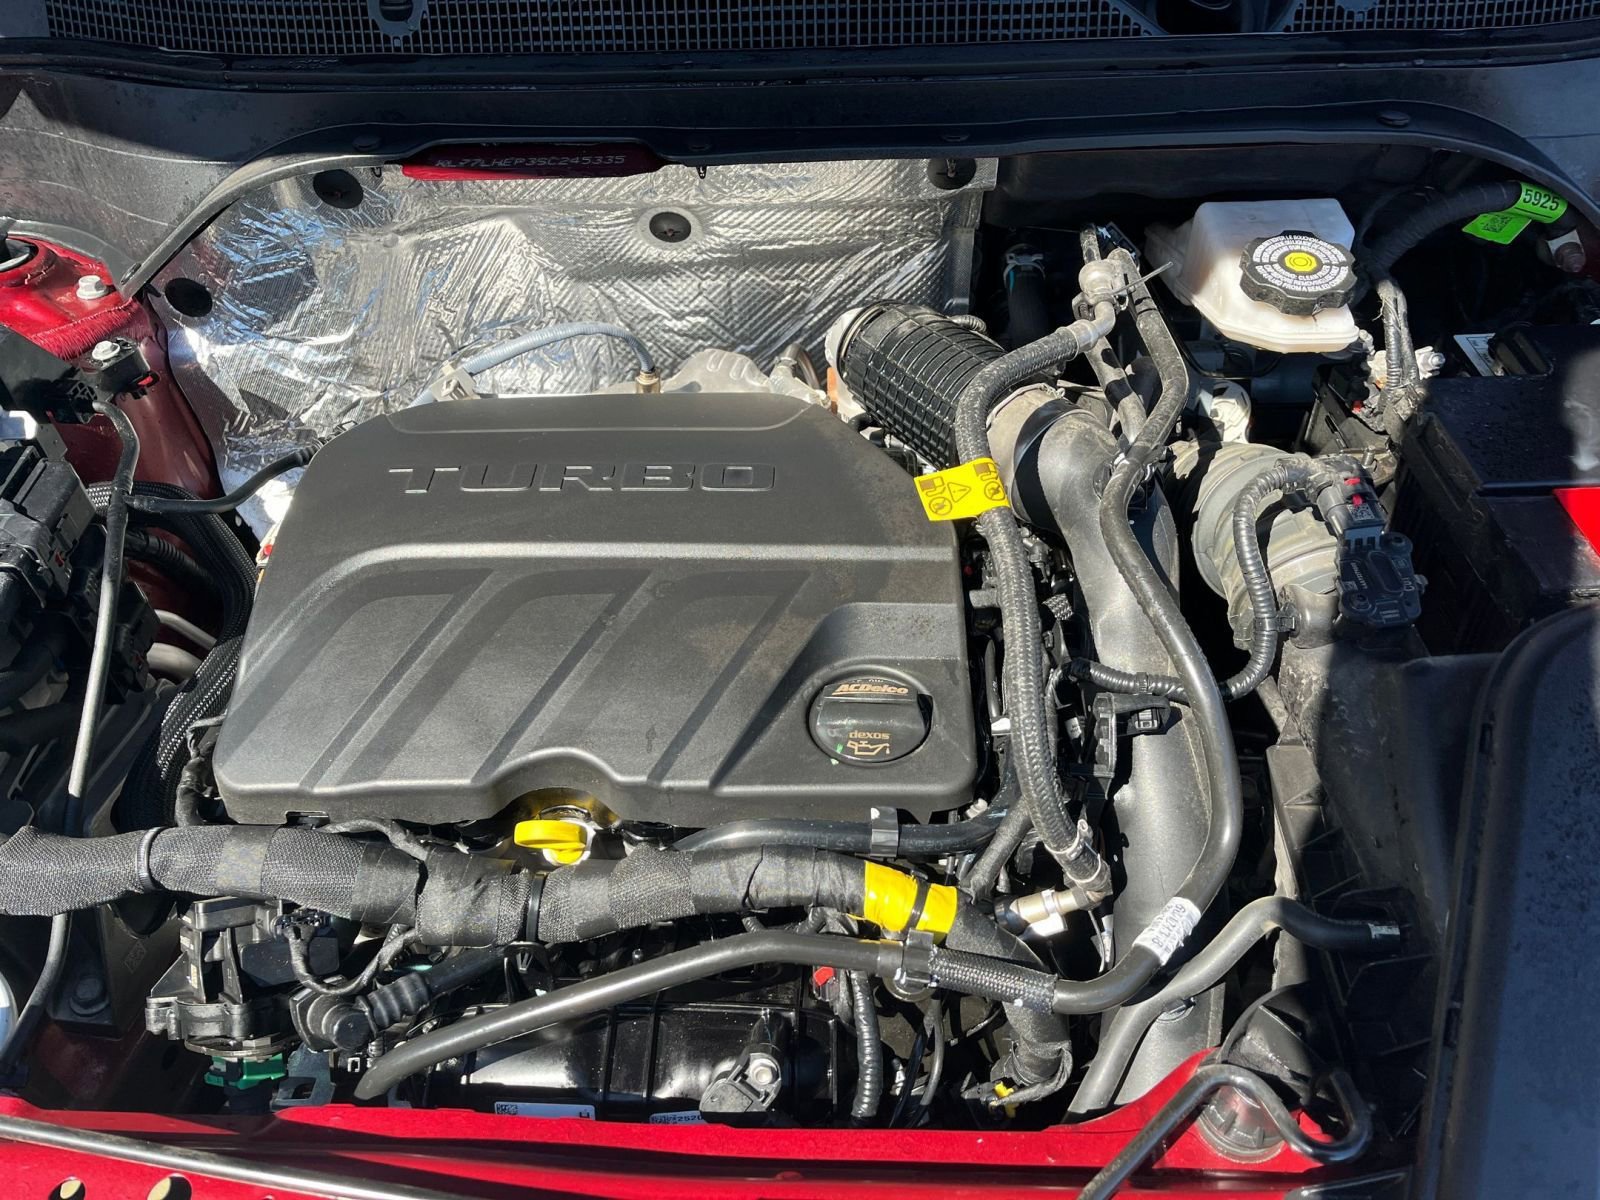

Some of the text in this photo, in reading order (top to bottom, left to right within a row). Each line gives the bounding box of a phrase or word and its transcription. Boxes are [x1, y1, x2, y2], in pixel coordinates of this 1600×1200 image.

[1523, 188, 1560, 211] 5925
[1282, 282, 1302, 292] FROM
[388, 463, 776, 493] TURBO
[833, 684, 909, 695] ACDelco
[849, 730, 891, 740] dexos
